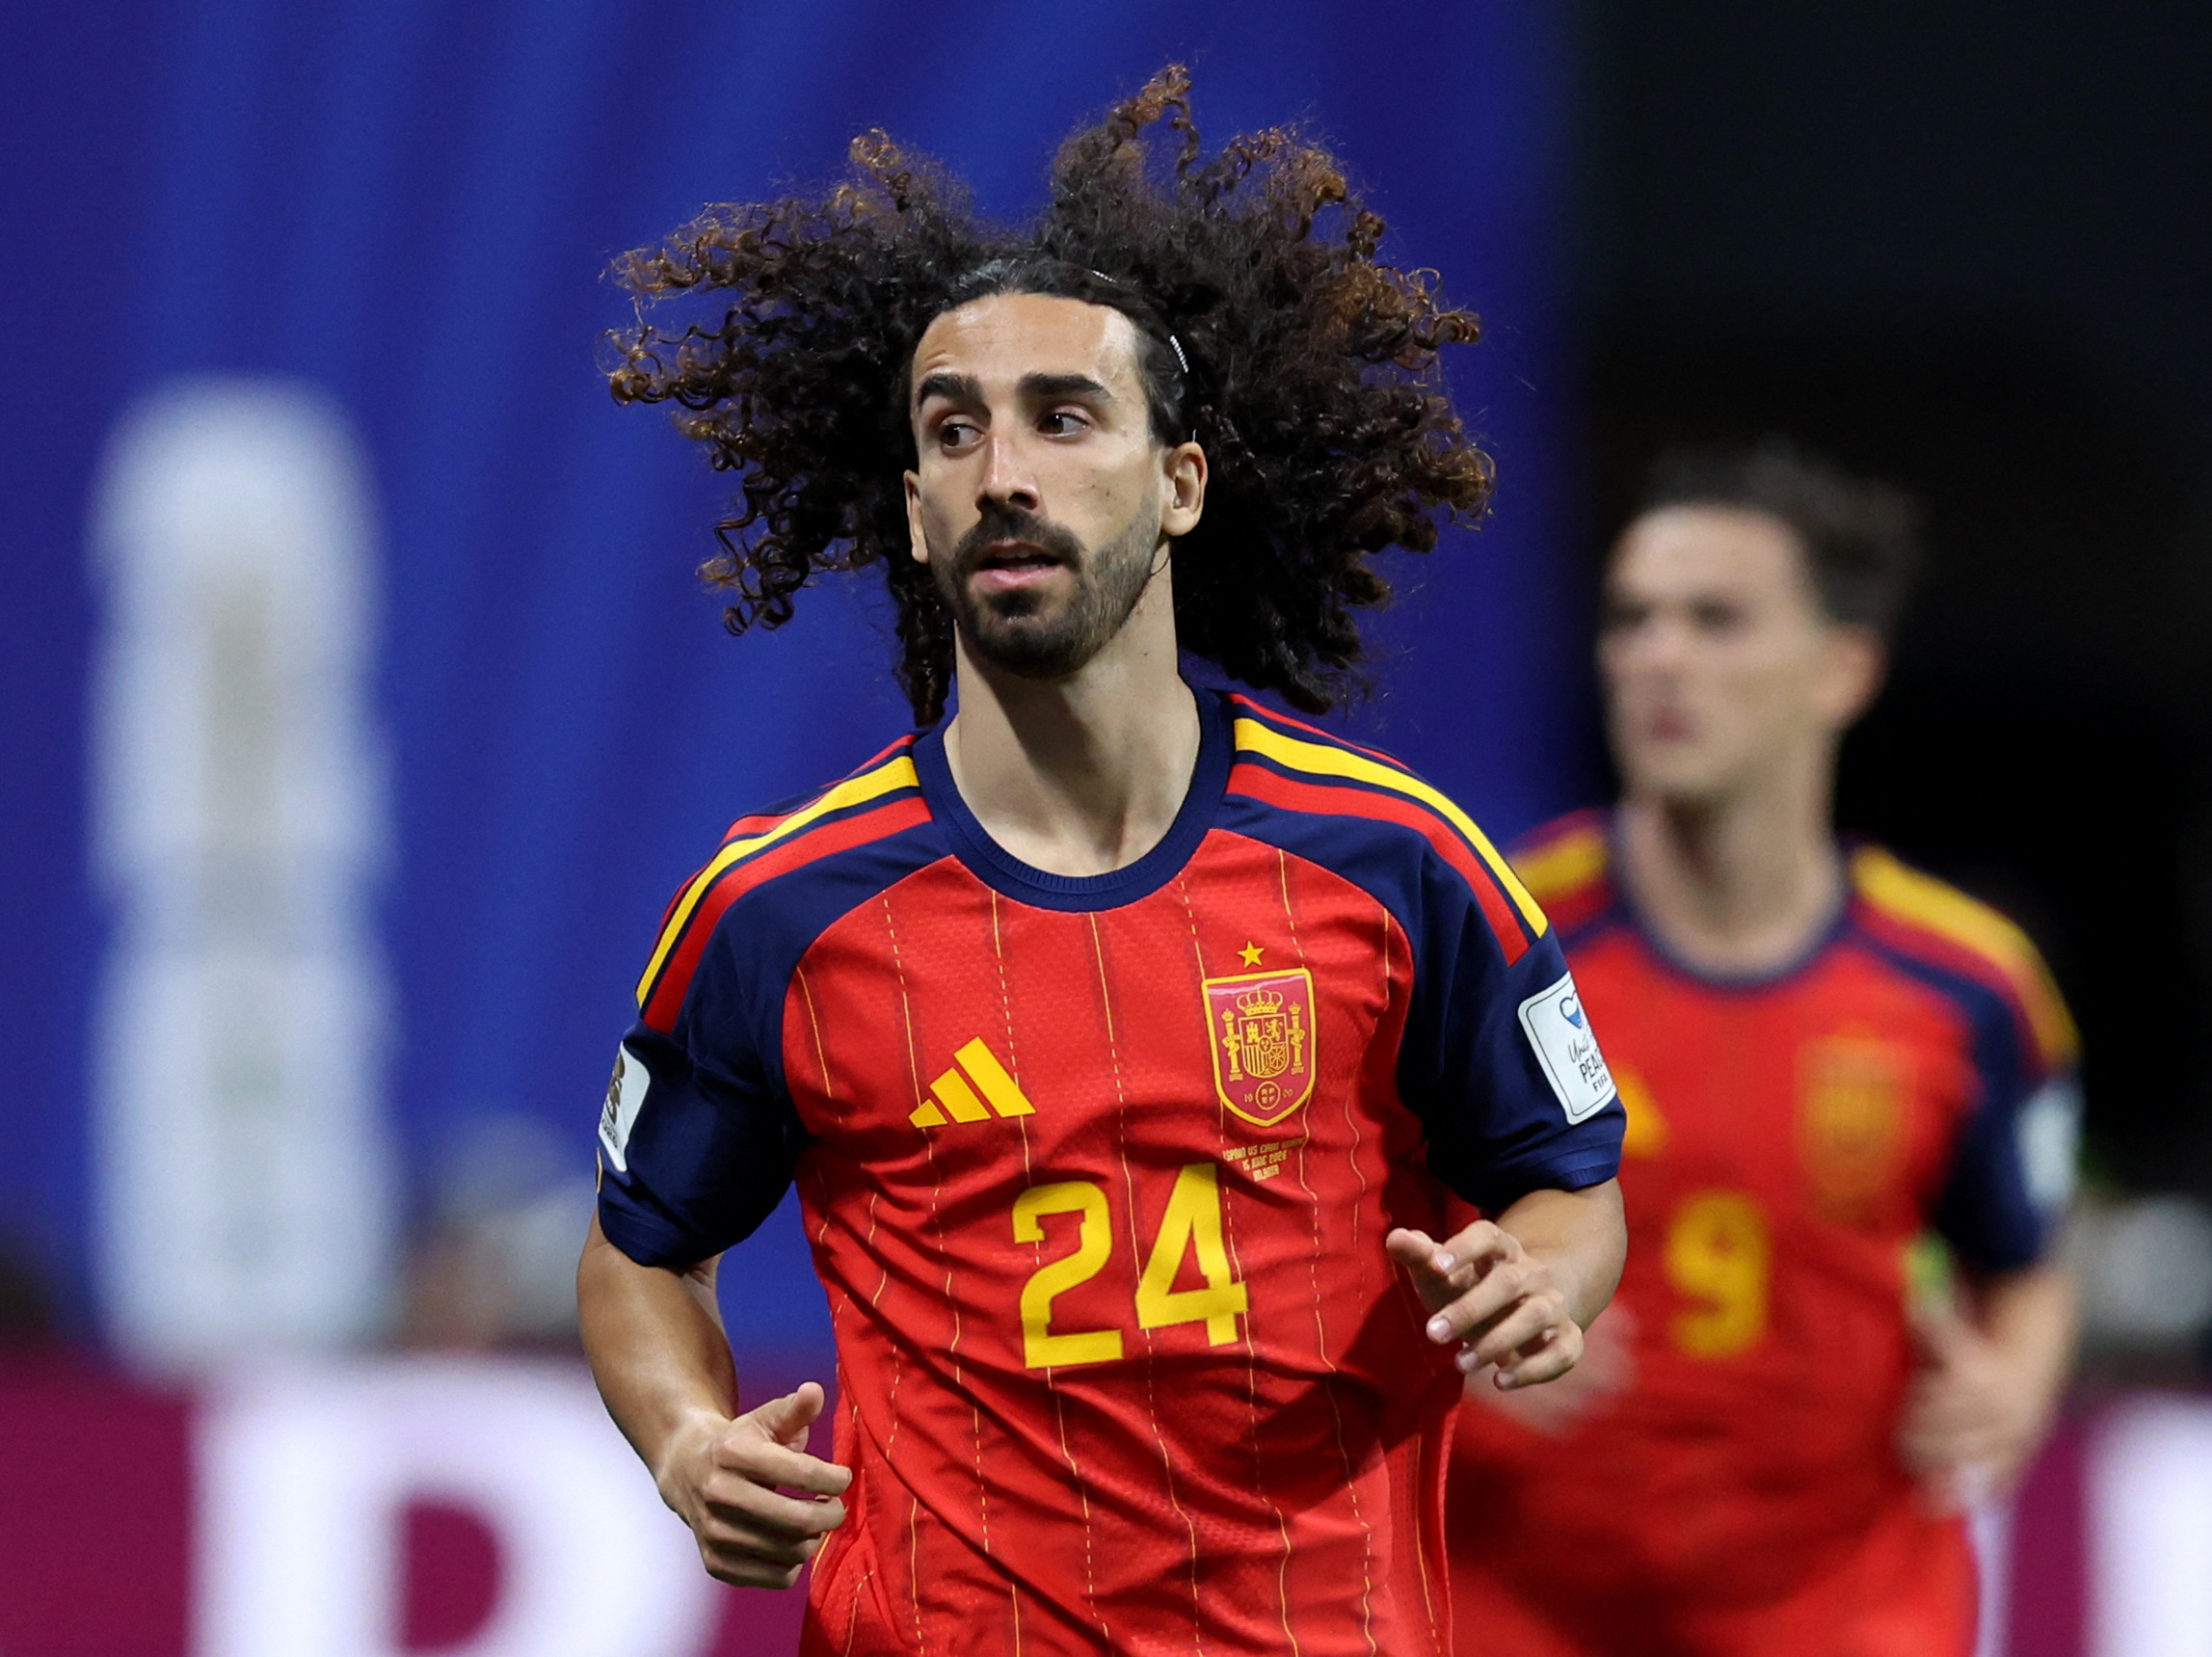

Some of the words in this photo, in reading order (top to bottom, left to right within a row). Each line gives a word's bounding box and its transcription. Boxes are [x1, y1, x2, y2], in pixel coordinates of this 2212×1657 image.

[1592, 1073, 1609, 1092] FIFA
[1012, 1163, 1249, 1369] 24
[1665, 1189, 1771, 1360] 9
